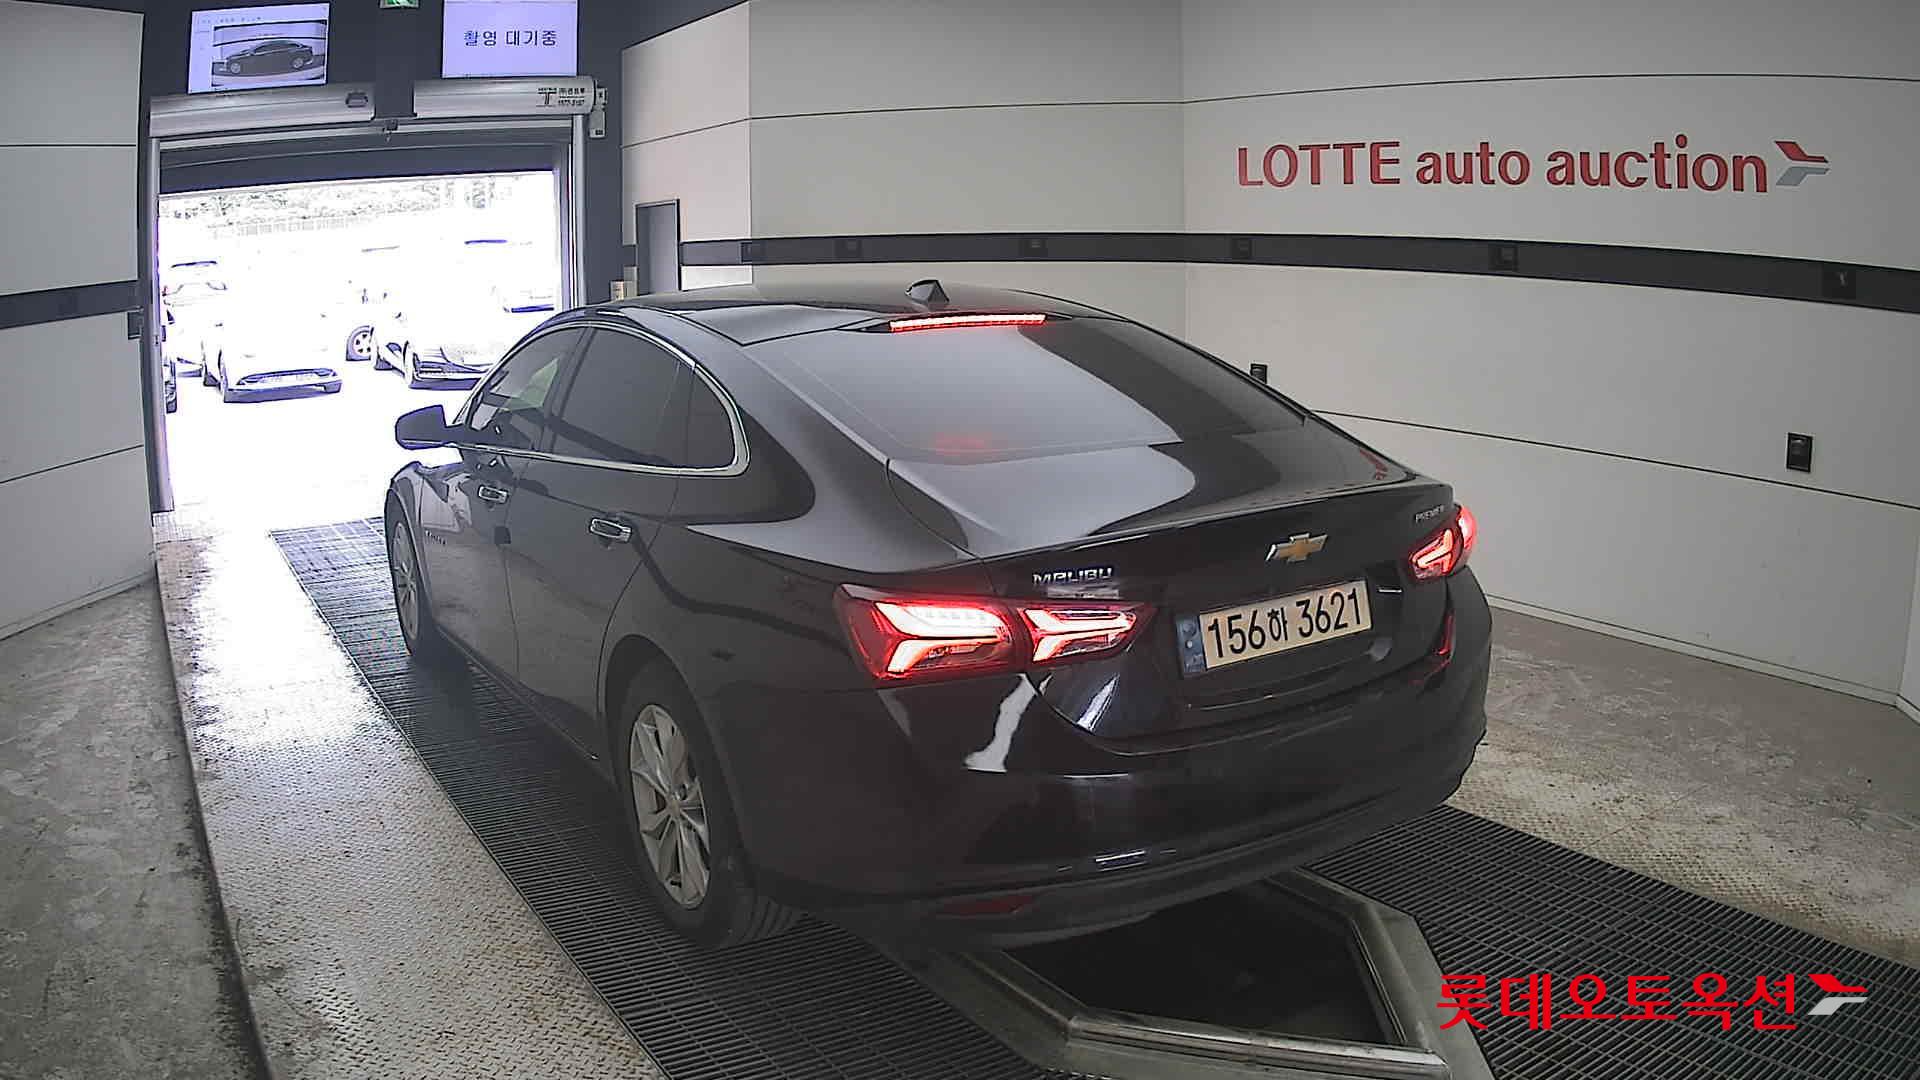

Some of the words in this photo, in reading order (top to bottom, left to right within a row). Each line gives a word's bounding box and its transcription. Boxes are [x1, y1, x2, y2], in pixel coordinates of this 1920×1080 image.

[463, 30, 498, 47] 촬영
[505, 30, 558, 47] 대기중
[1236, 140, 1401, 188] LOTTE
[1415, 140, 1531, 187] auto
[1545, 133, 1768, 193] auction
[1032, 567, 1113, 585] MALIBU
[1207, 606, 1289, 659] 156하
[1295, 587, 1362, 639] 3621
